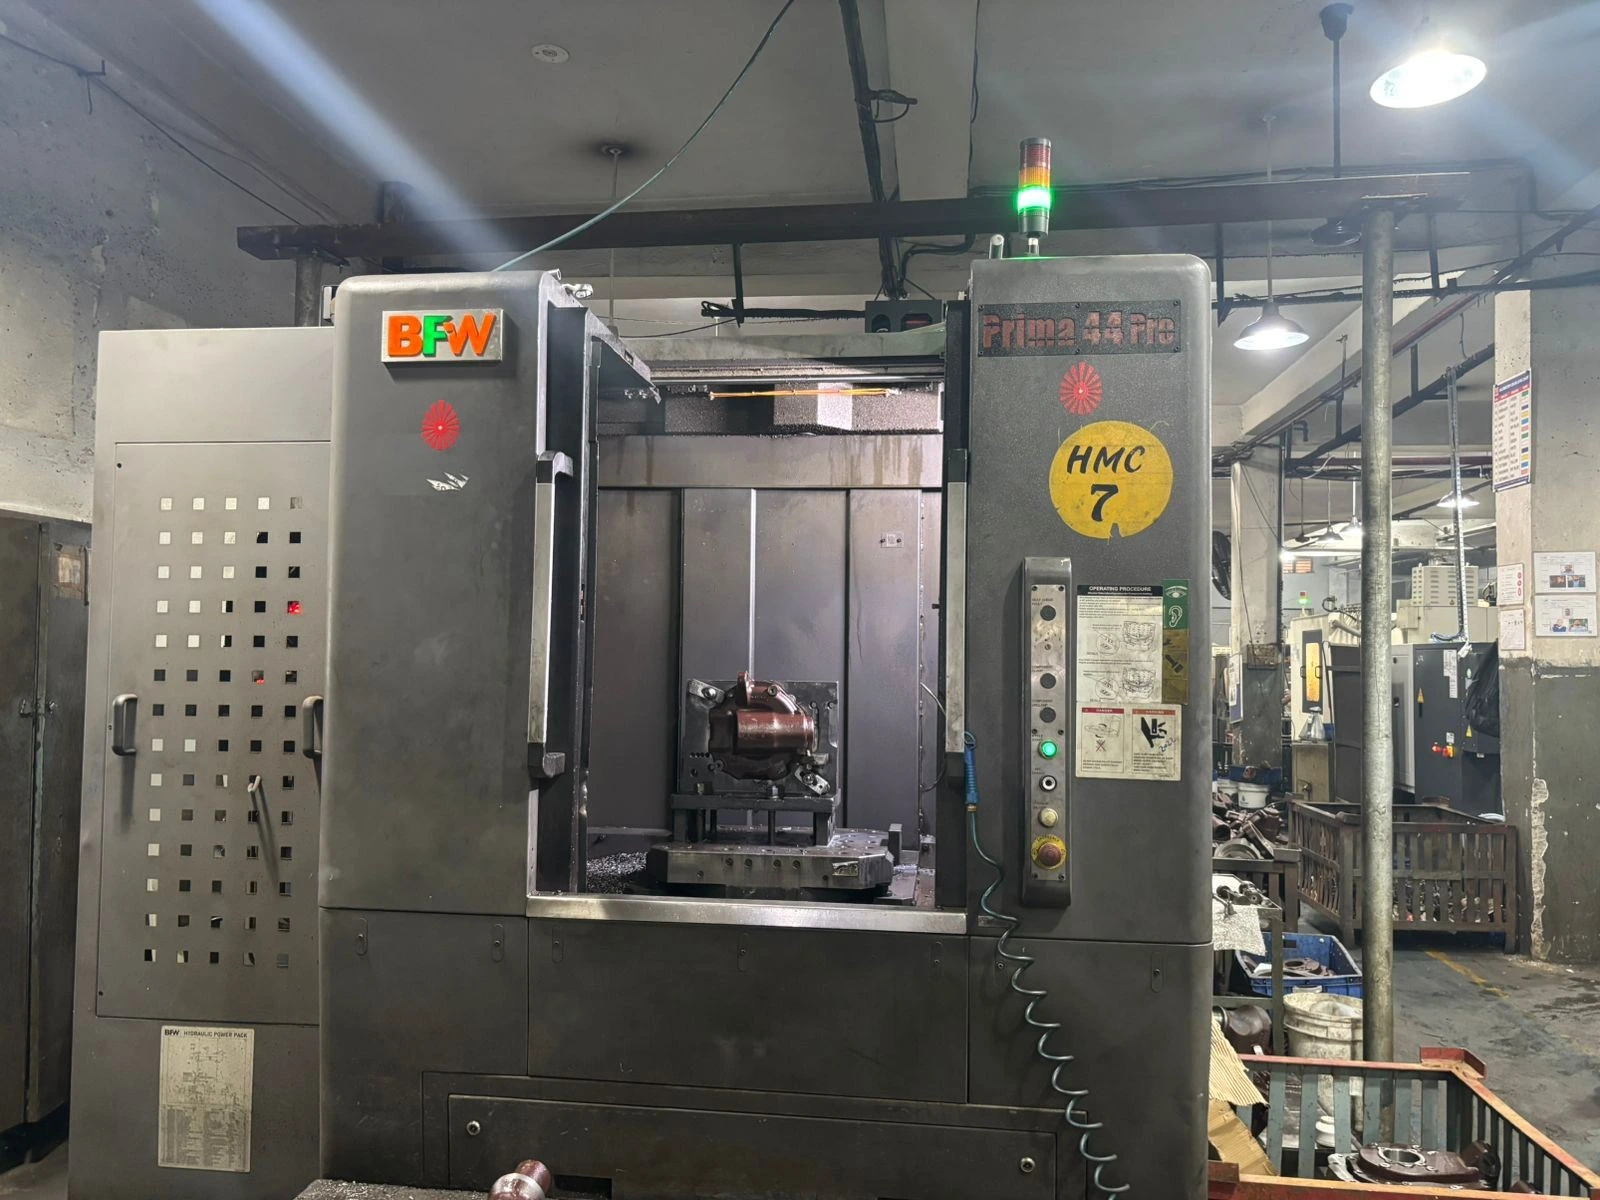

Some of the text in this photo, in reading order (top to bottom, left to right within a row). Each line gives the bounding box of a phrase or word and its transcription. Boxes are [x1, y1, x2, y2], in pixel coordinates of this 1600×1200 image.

[387, 312, 497, 358] BFW
[982, 310, 1176, 349] Prima 44 Pro
[1066, 445, 1146, 474] HMC
[1090, 483, 1119, 522] 7
